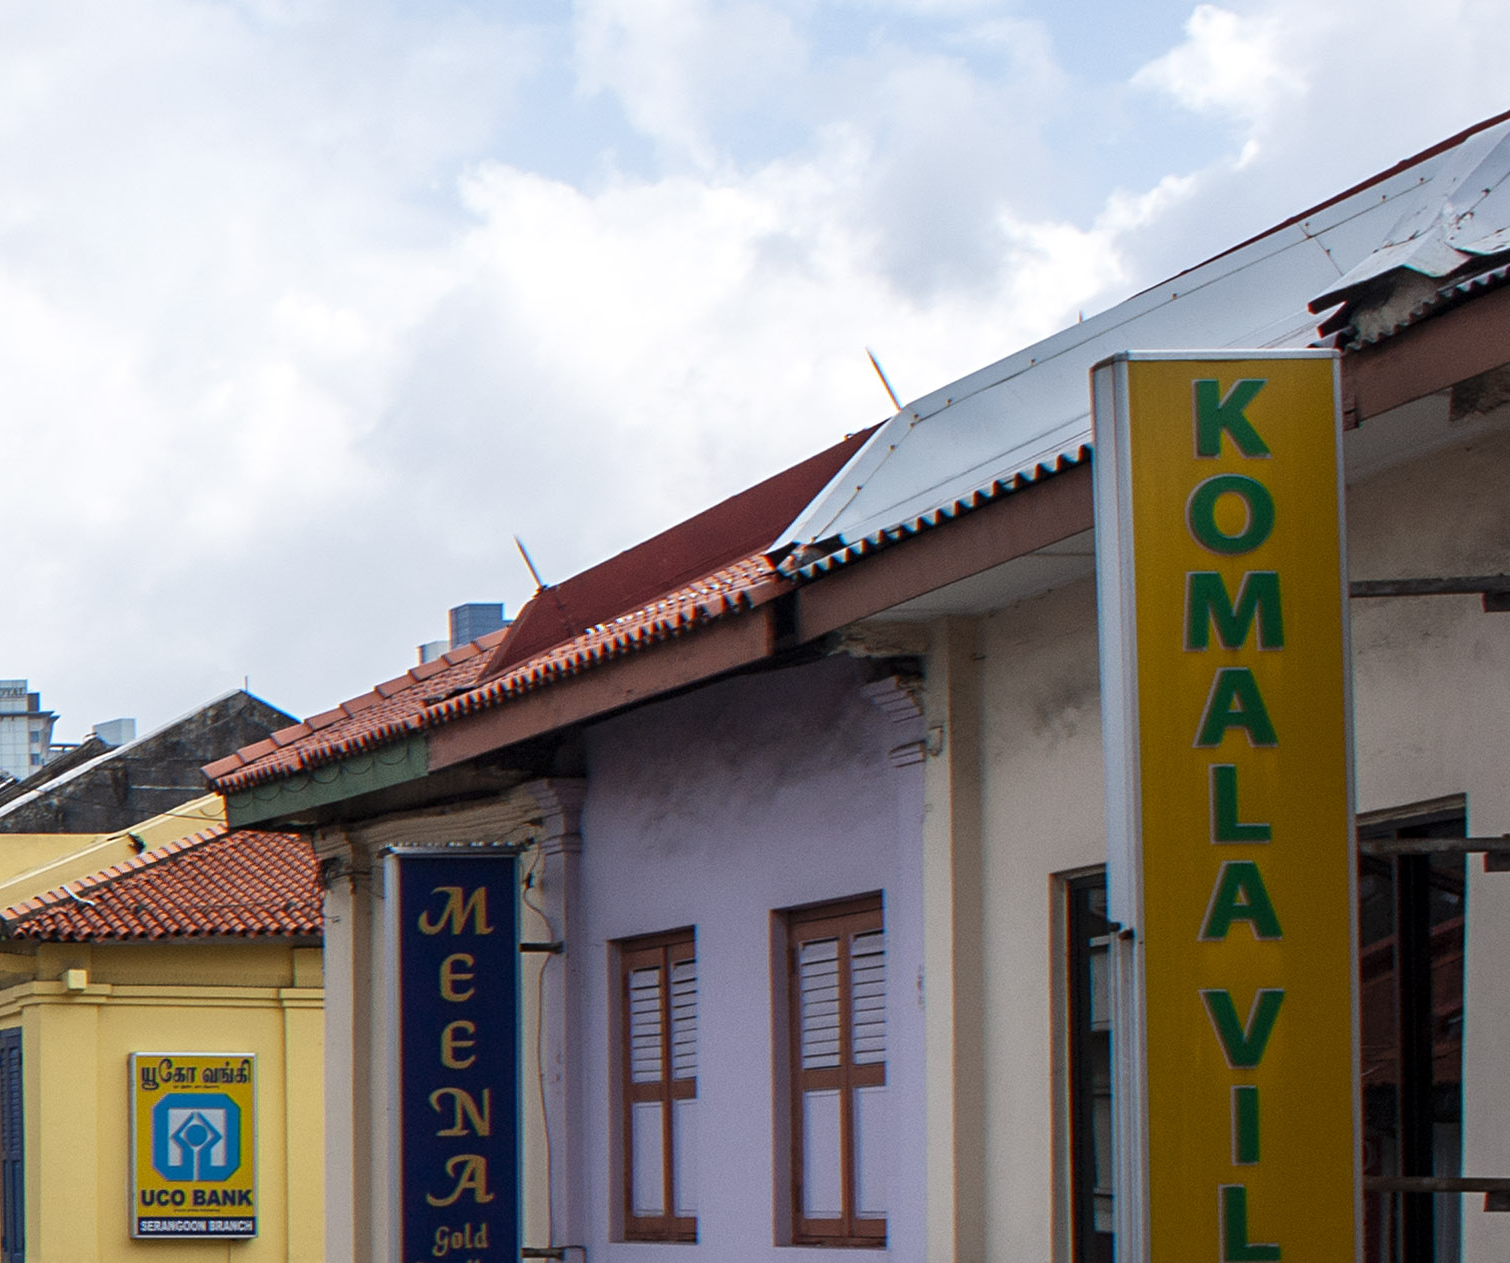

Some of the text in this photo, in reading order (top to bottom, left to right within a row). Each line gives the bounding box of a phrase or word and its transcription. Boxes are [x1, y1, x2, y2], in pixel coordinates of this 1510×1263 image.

[1183, 379, 1285, 941] KOMALA
[418, 886, 494, 1208] MEENA
[140, 1189, 253, 1207] UCO BANK
[139, 1219, 253, 1232] SERANGOON BRANCH
[432, 1227, 488, 1257] Gold
